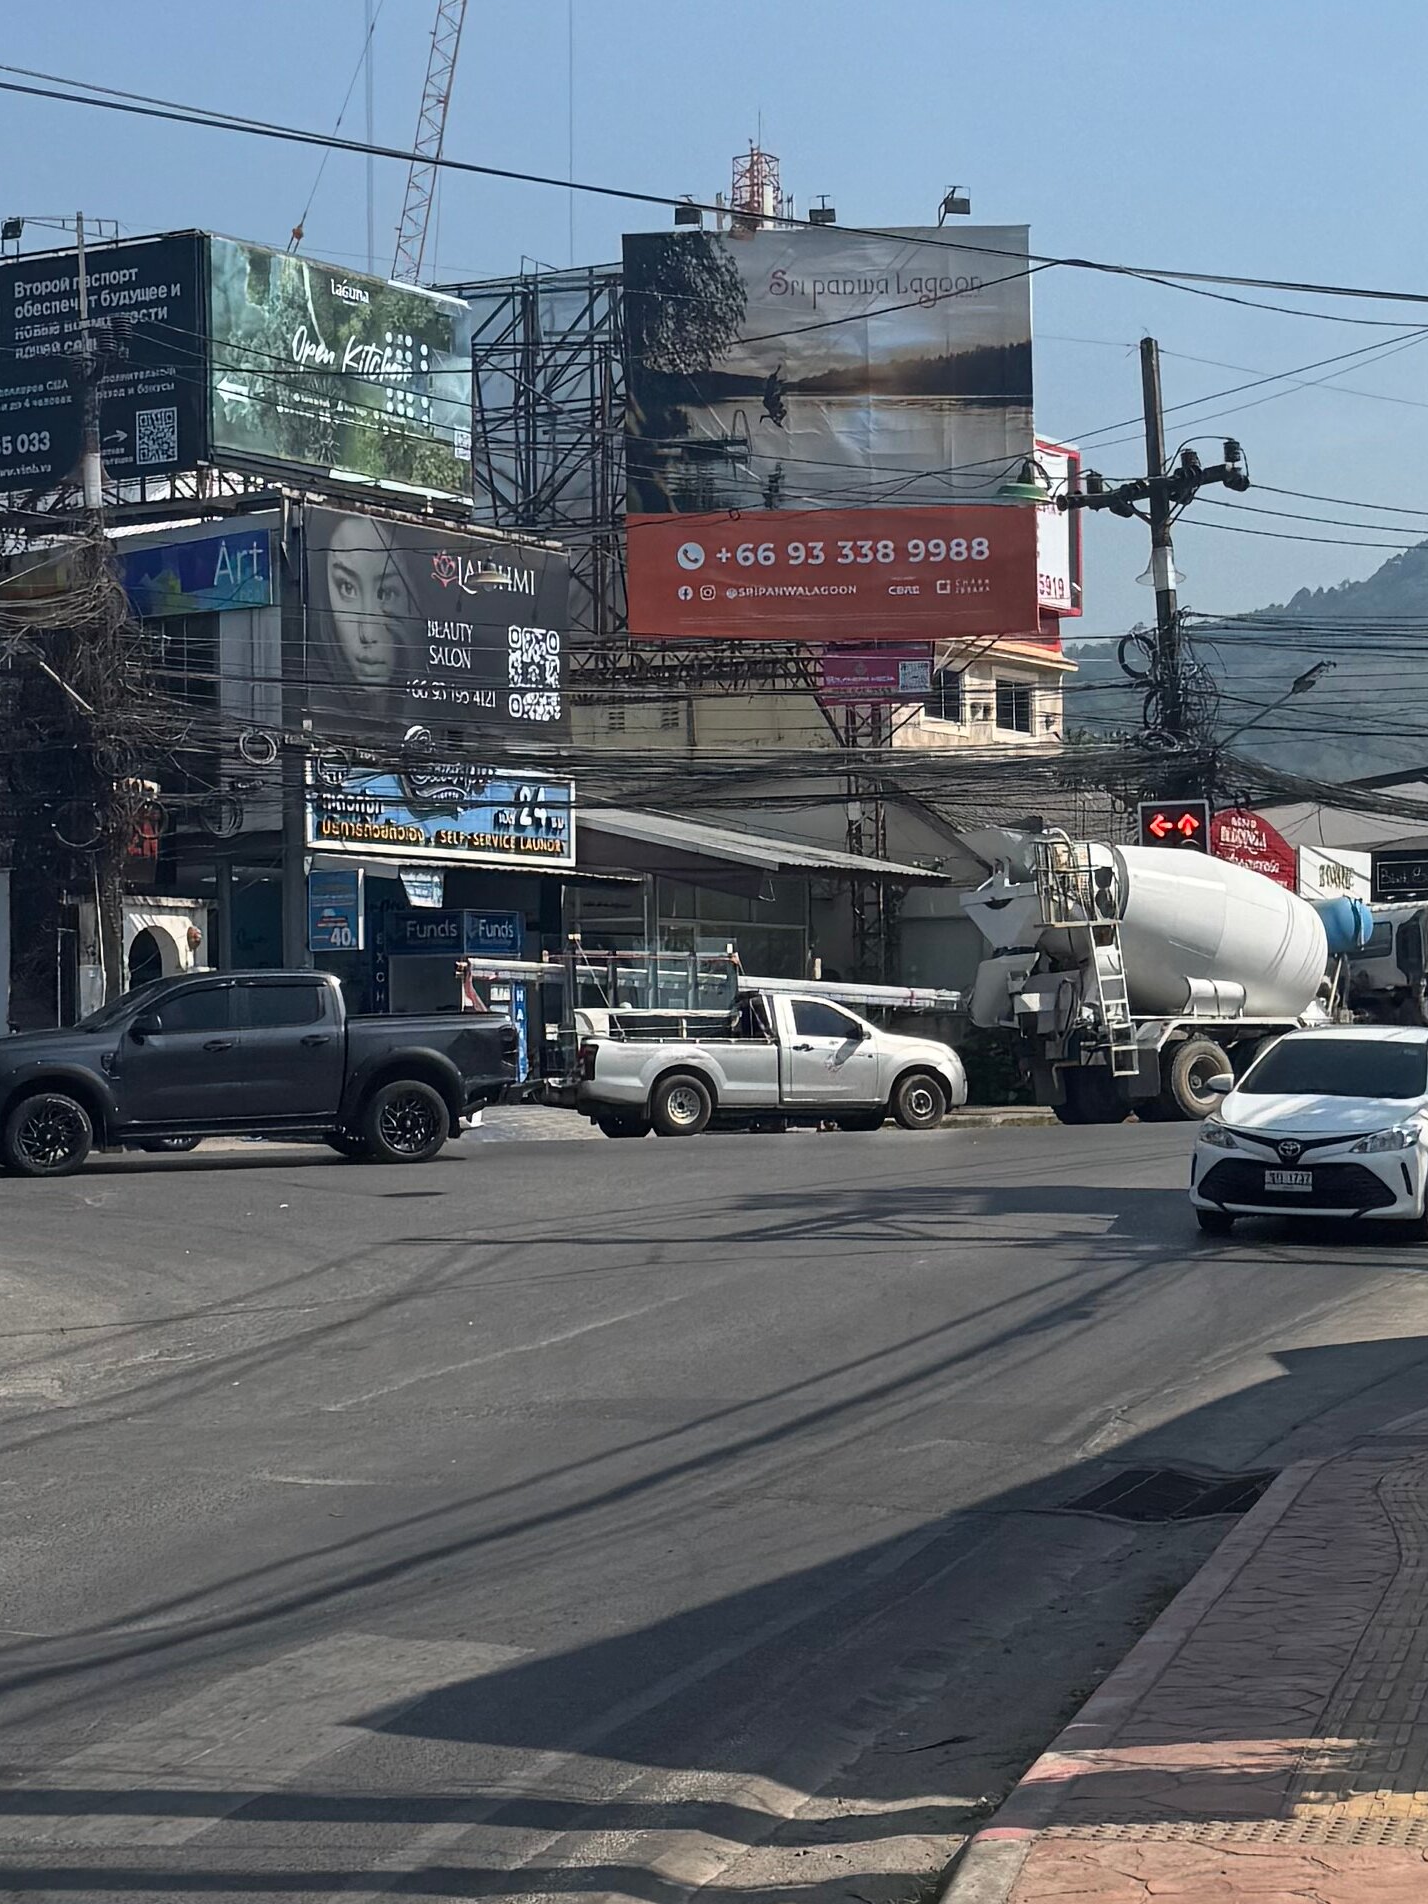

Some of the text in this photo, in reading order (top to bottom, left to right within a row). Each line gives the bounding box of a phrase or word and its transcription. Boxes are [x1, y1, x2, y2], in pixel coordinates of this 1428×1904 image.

[14, 277, 70, 298] Второй
[769, 269, 982, 310] Sri panwa Lagoon
[14, 283, 181, 319] обеспечт будущее и
[292, 326, 335, 372] Open
[16, 431, 51, 454] 033
[716, 537, 990, 567] +66 93 338 9988
[427, 619, 473, 643] BEAUTY
[429, 645, 471, 669] SALON
[406, 919, 514, 938] Funds Funds
